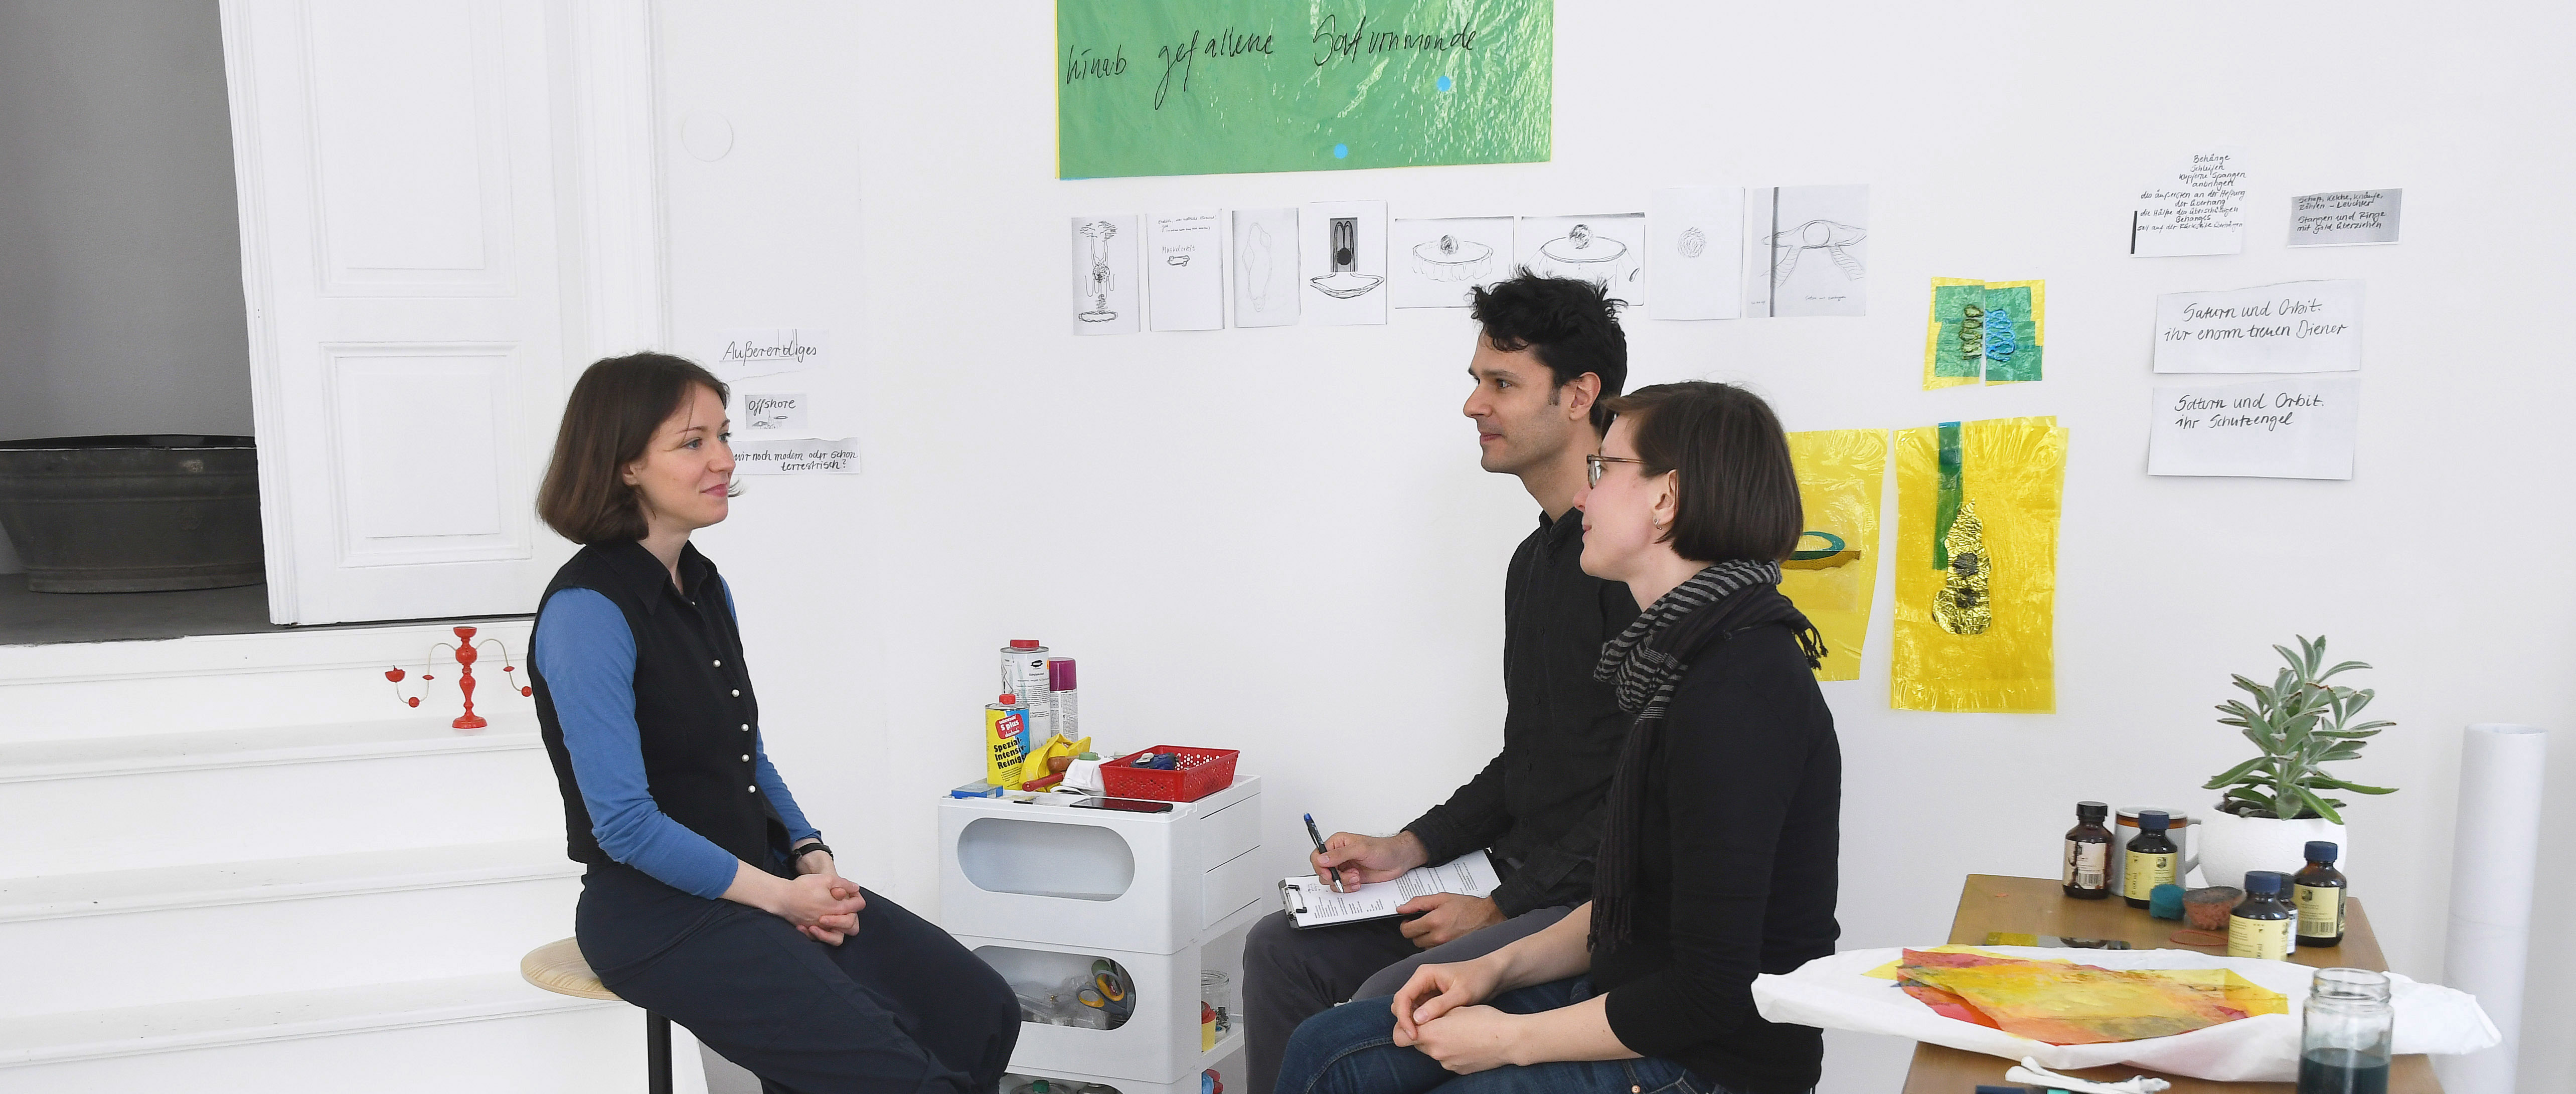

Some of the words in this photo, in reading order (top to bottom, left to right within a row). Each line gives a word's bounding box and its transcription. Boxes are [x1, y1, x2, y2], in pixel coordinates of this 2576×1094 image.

[1065, 44, 1128, 86] hinab
[2193, 153, 2230, 165] Behänge
[2336, 211, 2356, 221] und
[2297, 224, 2311, 232] mit
[2182, 302, 2237, 322] Saturn
[2241, 301, 2272, 317] und
[2164, 327, 2192, 342] ihr
[2197, 328, 2246, 341] enorm
[2245, 325, 2291, 338] treuen
[2296, 320, 2349, 339] Diener
[2174, 394, 2227, 411] Saturn
[2233, 393, 2268, 409] und
[2175, 414, 2200, 430] ihr
[2208, 412, 2295, 432] Schutzengel
[752, 450, 772, 461] noch
[808, 449, 828, 459] oder
[1006, 720, 1019, 730] plus
